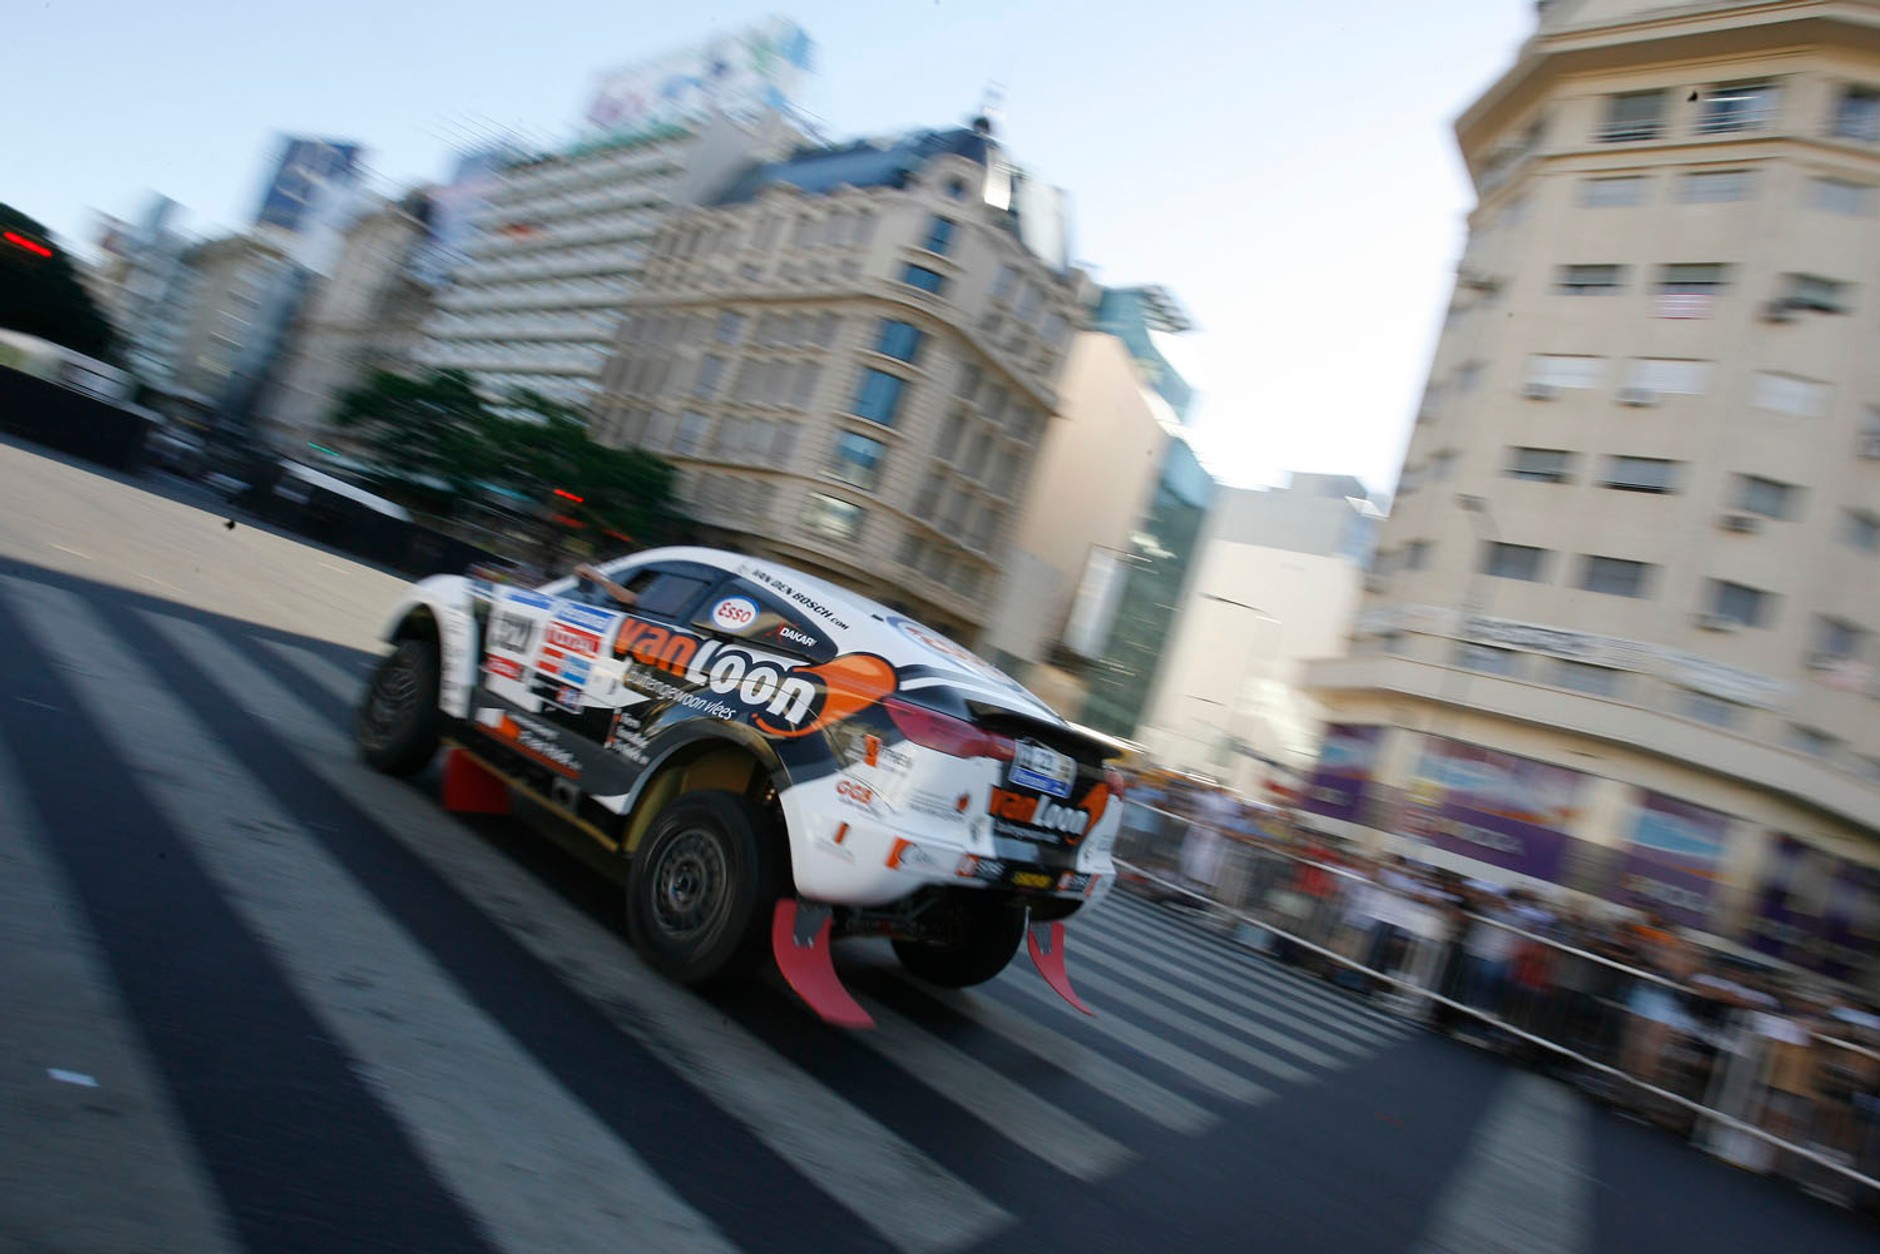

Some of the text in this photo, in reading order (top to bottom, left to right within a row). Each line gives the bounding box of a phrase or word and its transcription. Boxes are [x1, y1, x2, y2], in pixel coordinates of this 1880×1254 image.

[771, 578, 793, 597] DEN
[780, 626, 814, 647] DAKAR
[703, 700, 737, 721] vlees
